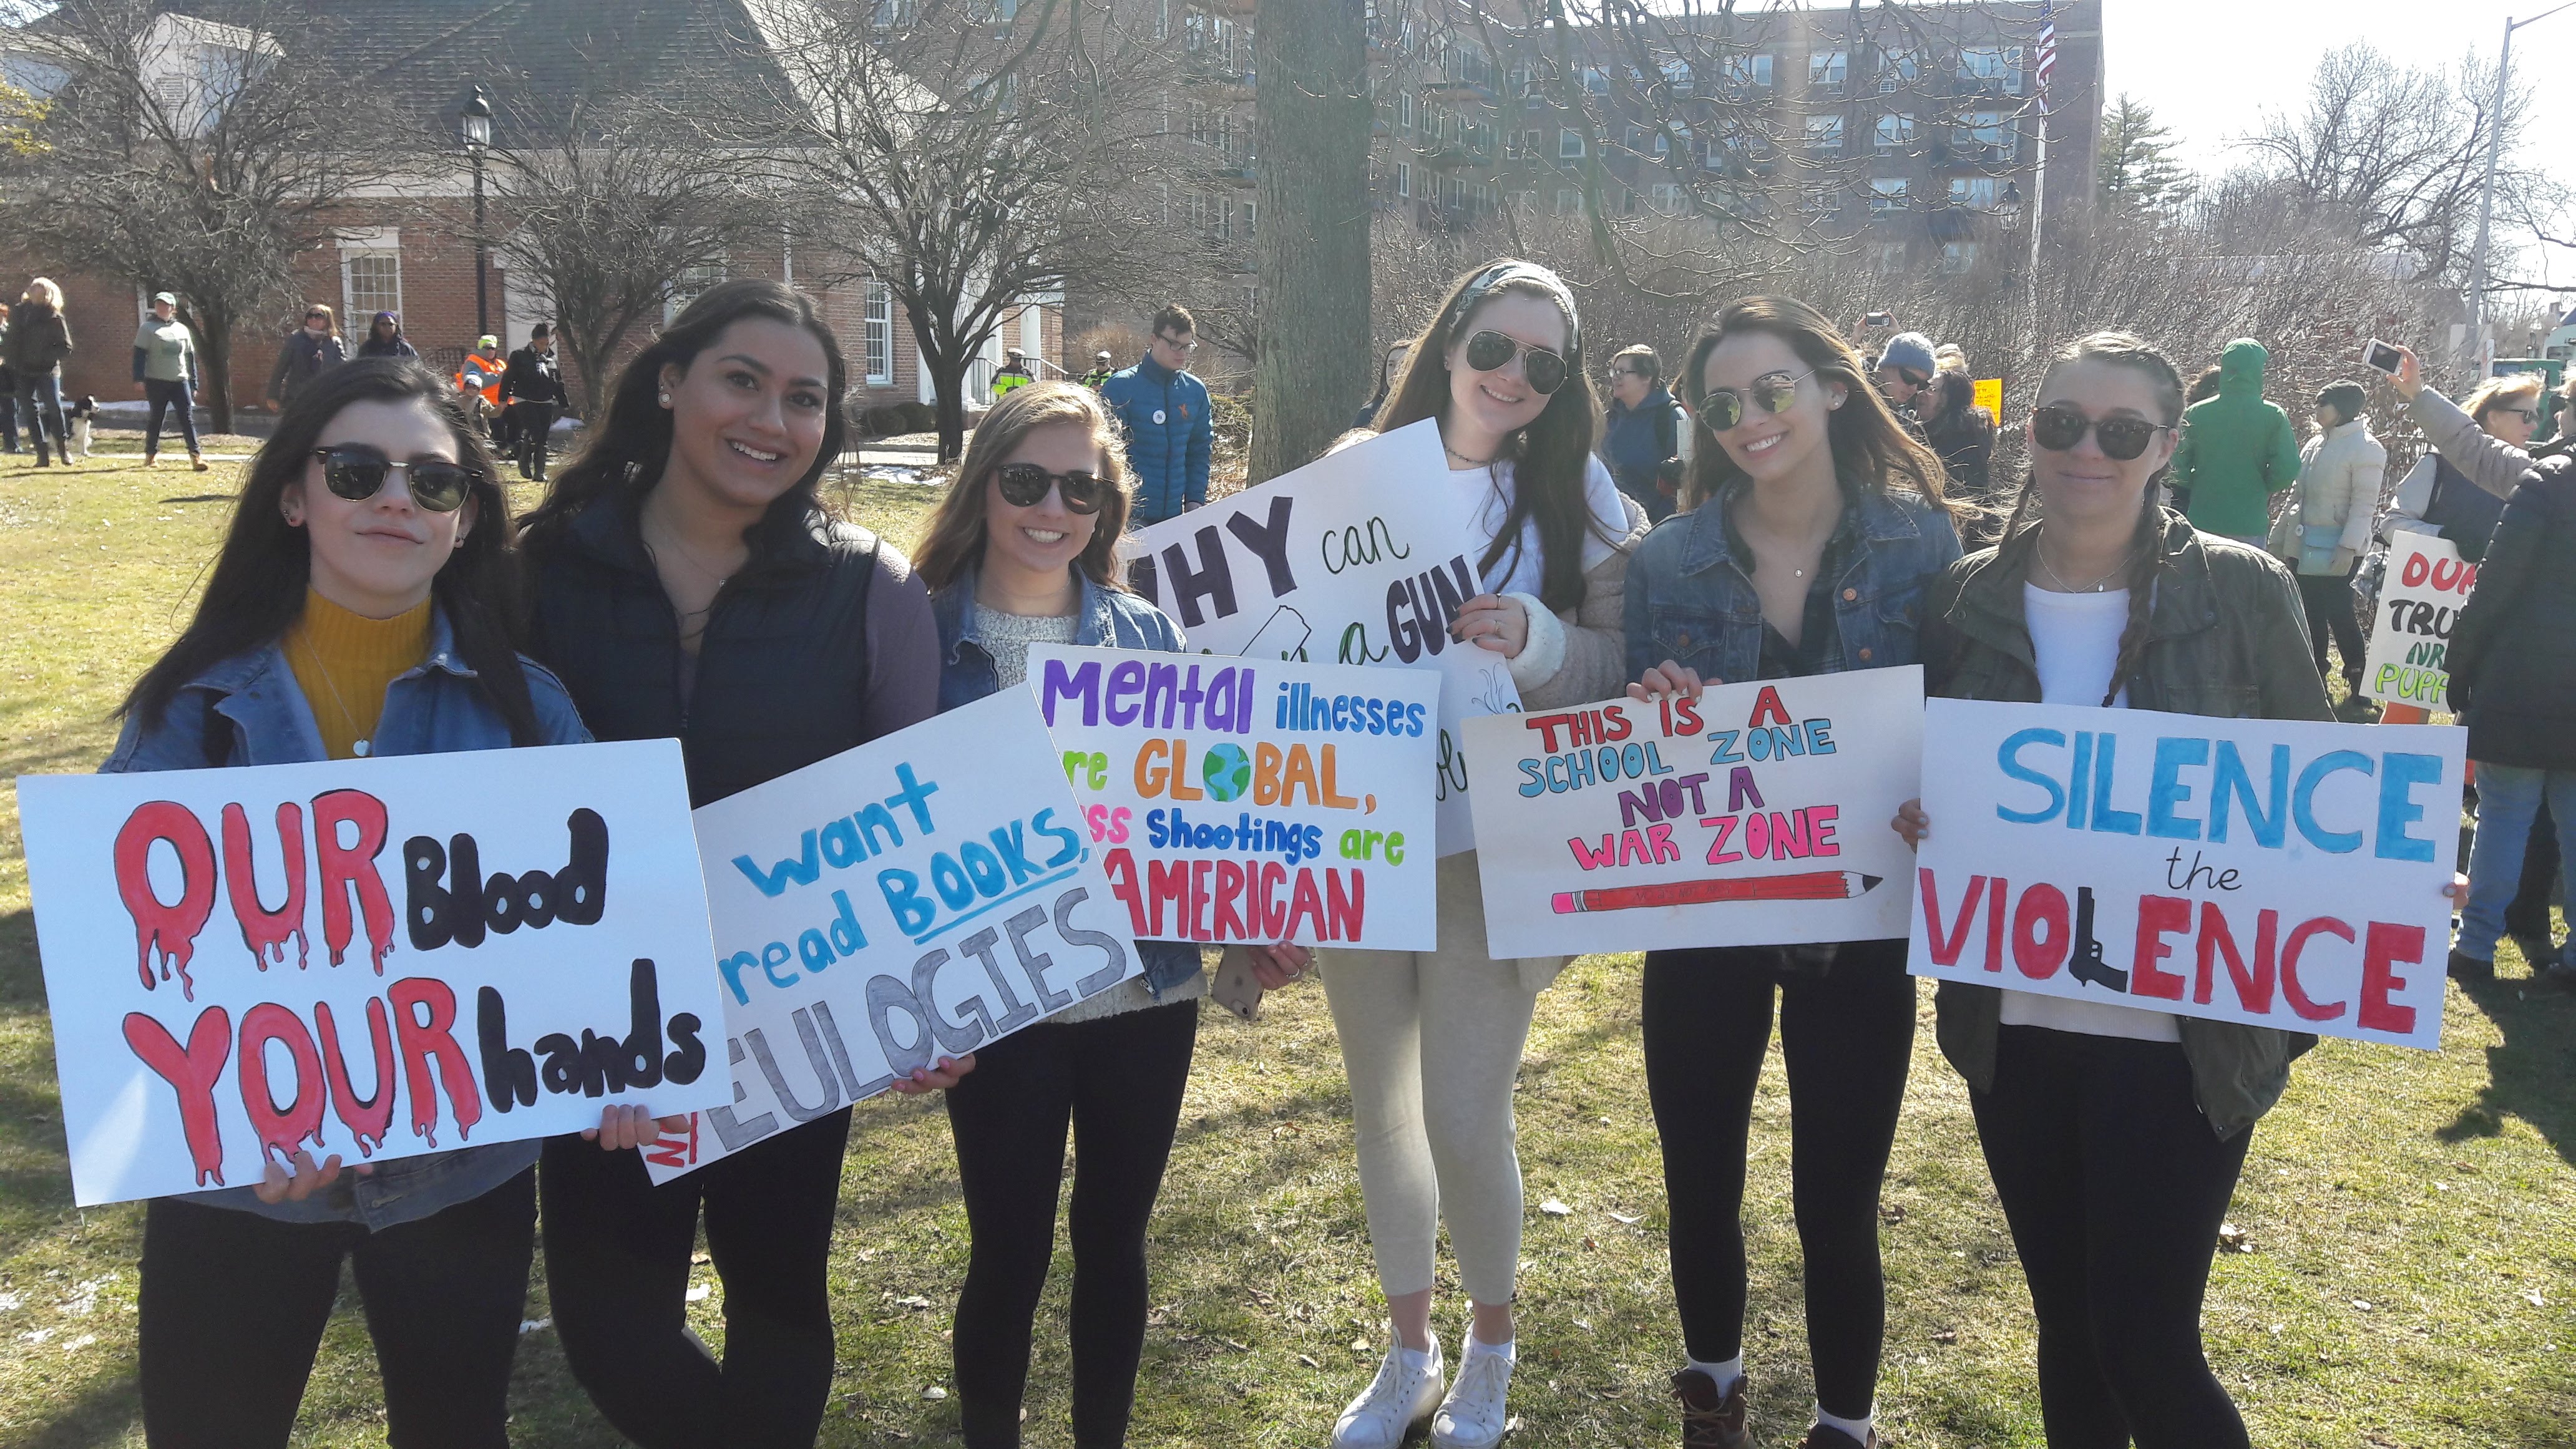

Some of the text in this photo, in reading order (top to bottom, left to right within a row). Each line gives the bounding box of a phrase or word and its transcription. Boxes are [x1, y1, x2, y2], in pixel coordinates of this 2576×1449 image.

[1322, 516, 1410, 574] can
[1387, 554, 1476, 664] GUN
[1042, 659, 1426, 738] Mental illnesses
[1526, 686, 1792, 753] THIS IS A
[1134, 739, 1377, 816] GLOBAL,
[1518, 742, 1673, 798] SCHOOL
[1707, 718, 1837, 765] ZONE
[1618, 767, 1765, 827] NOT A
[1996, 728, 2442, 862] SILENCE
[731, 761, 939, 897] want
[1339, 829, 1405, 866] are
[1569, 805, 1840, 871] WAR ZONE
[2166, 846, 2242, 890] the
[114, 788, 609, 1001] OUR Blood
[718, 807, 1089, 1006] read BOOKS,
[1103, 848, 1365, 942] AMERICAN
[1918, 867, 2426, 1034] VIOLENCE
[706, 887, 1126, 1151] EULOGIES
[122, 958, 706, 1186] YOUR hands
